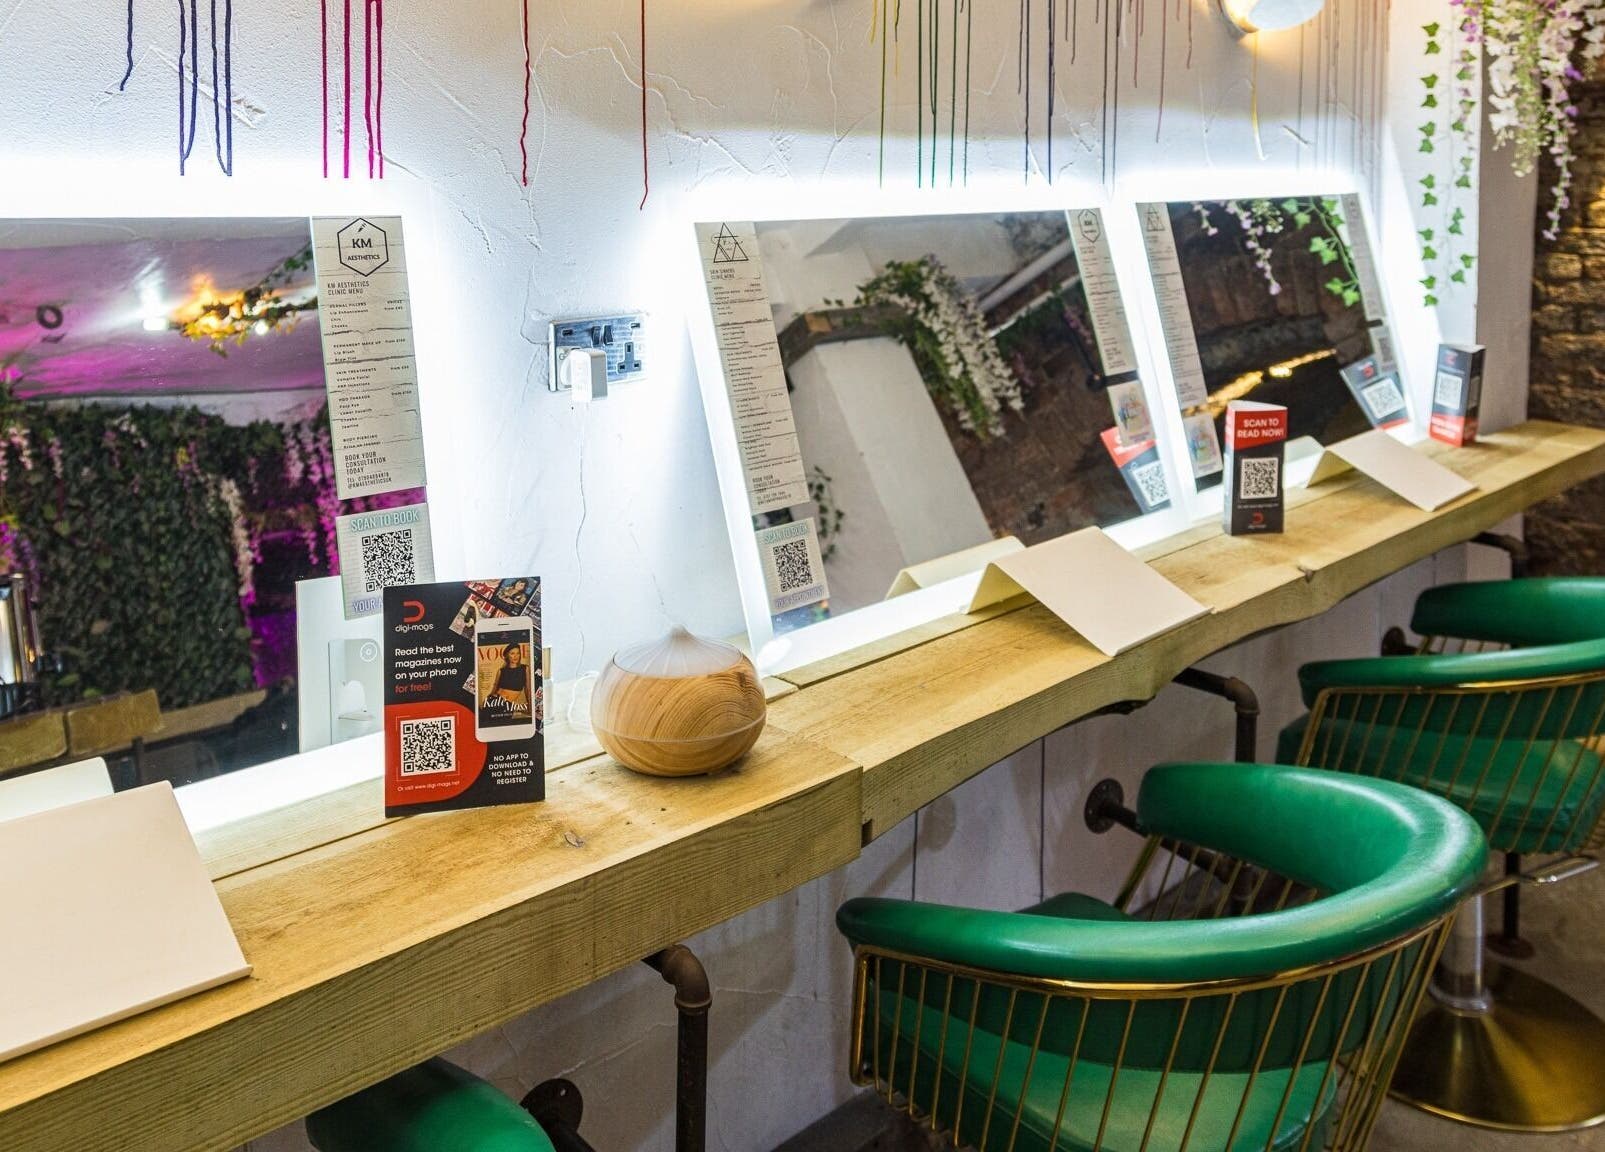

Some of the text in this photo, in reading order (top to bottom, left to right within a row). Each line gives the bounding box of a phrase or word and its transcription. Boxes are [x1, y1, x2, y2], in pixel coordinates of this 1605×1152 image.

[352, 238, 372, 249] KM
[1243, 418, 1279, 428] SCAN TO
[1237, 428, 1284, 438] READ NOW!
[362, 451, 376, 459] YOUR
[346, 457, 386, 468] CONSULTATION
[346, 467, 364, 475] TODAY
[350, 510, 419, 532] SCAN TO BOOK
[353, 598, 377, 613] YOUR
[395, 623, 434, 633] digi-mags
[395, 644, 454, 656] Read the best
[395, 656, 462, 669] magazines now
[395, 668, 458, 680] on your phone
[395, 682, 432, 694] for free!
[489, 760, 528, 770] DOWNLOAD
[504, 769, 522, 777] NEED
[497, 776, 527, 785] REGISTER
